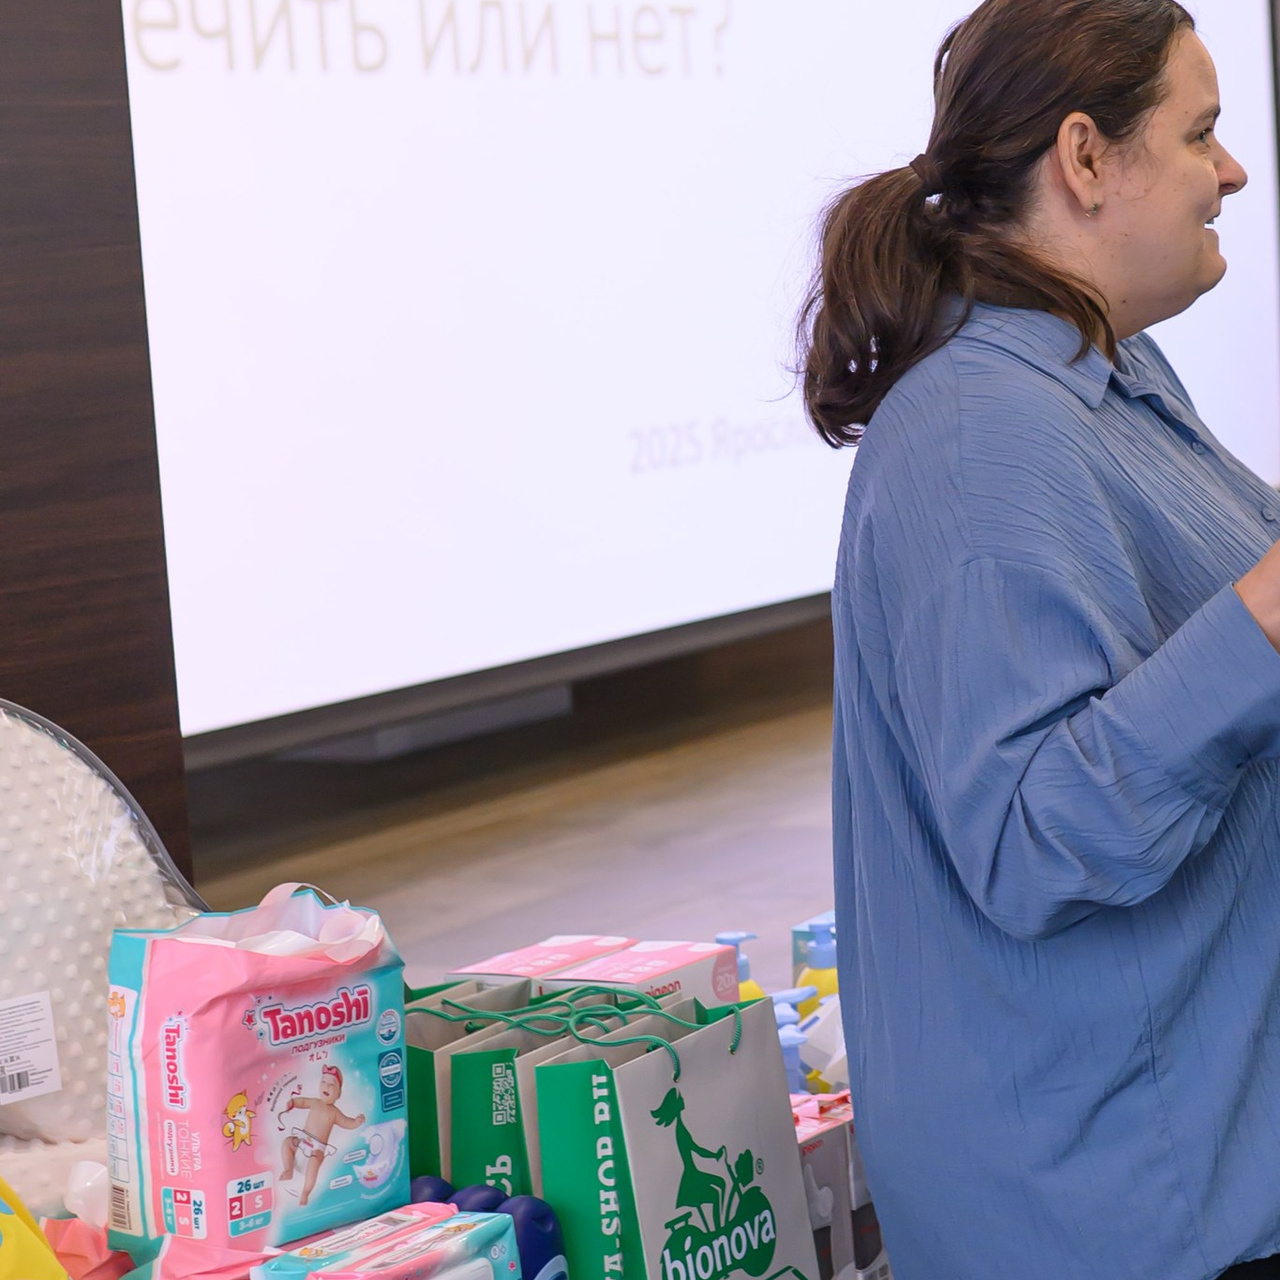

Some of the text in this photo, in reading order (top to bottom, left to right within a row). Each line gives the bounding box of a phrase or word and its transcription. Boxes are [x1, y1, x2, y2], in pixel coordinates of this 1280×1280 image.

[177, 1119, 192, 1179] ТОНКИЕ
[190, 1132, 202, 1172] УЛЬТРА
[237, 1178, 265, 1193] 26 шт
[177, 1191, 189, 1203] 2
[254, 1195, 263, 1209] S
[193, 1199, 203, 1231] 26 шт
[231, 1201, 241, 1215] 2
[178, 1215, 190, 1226] S
